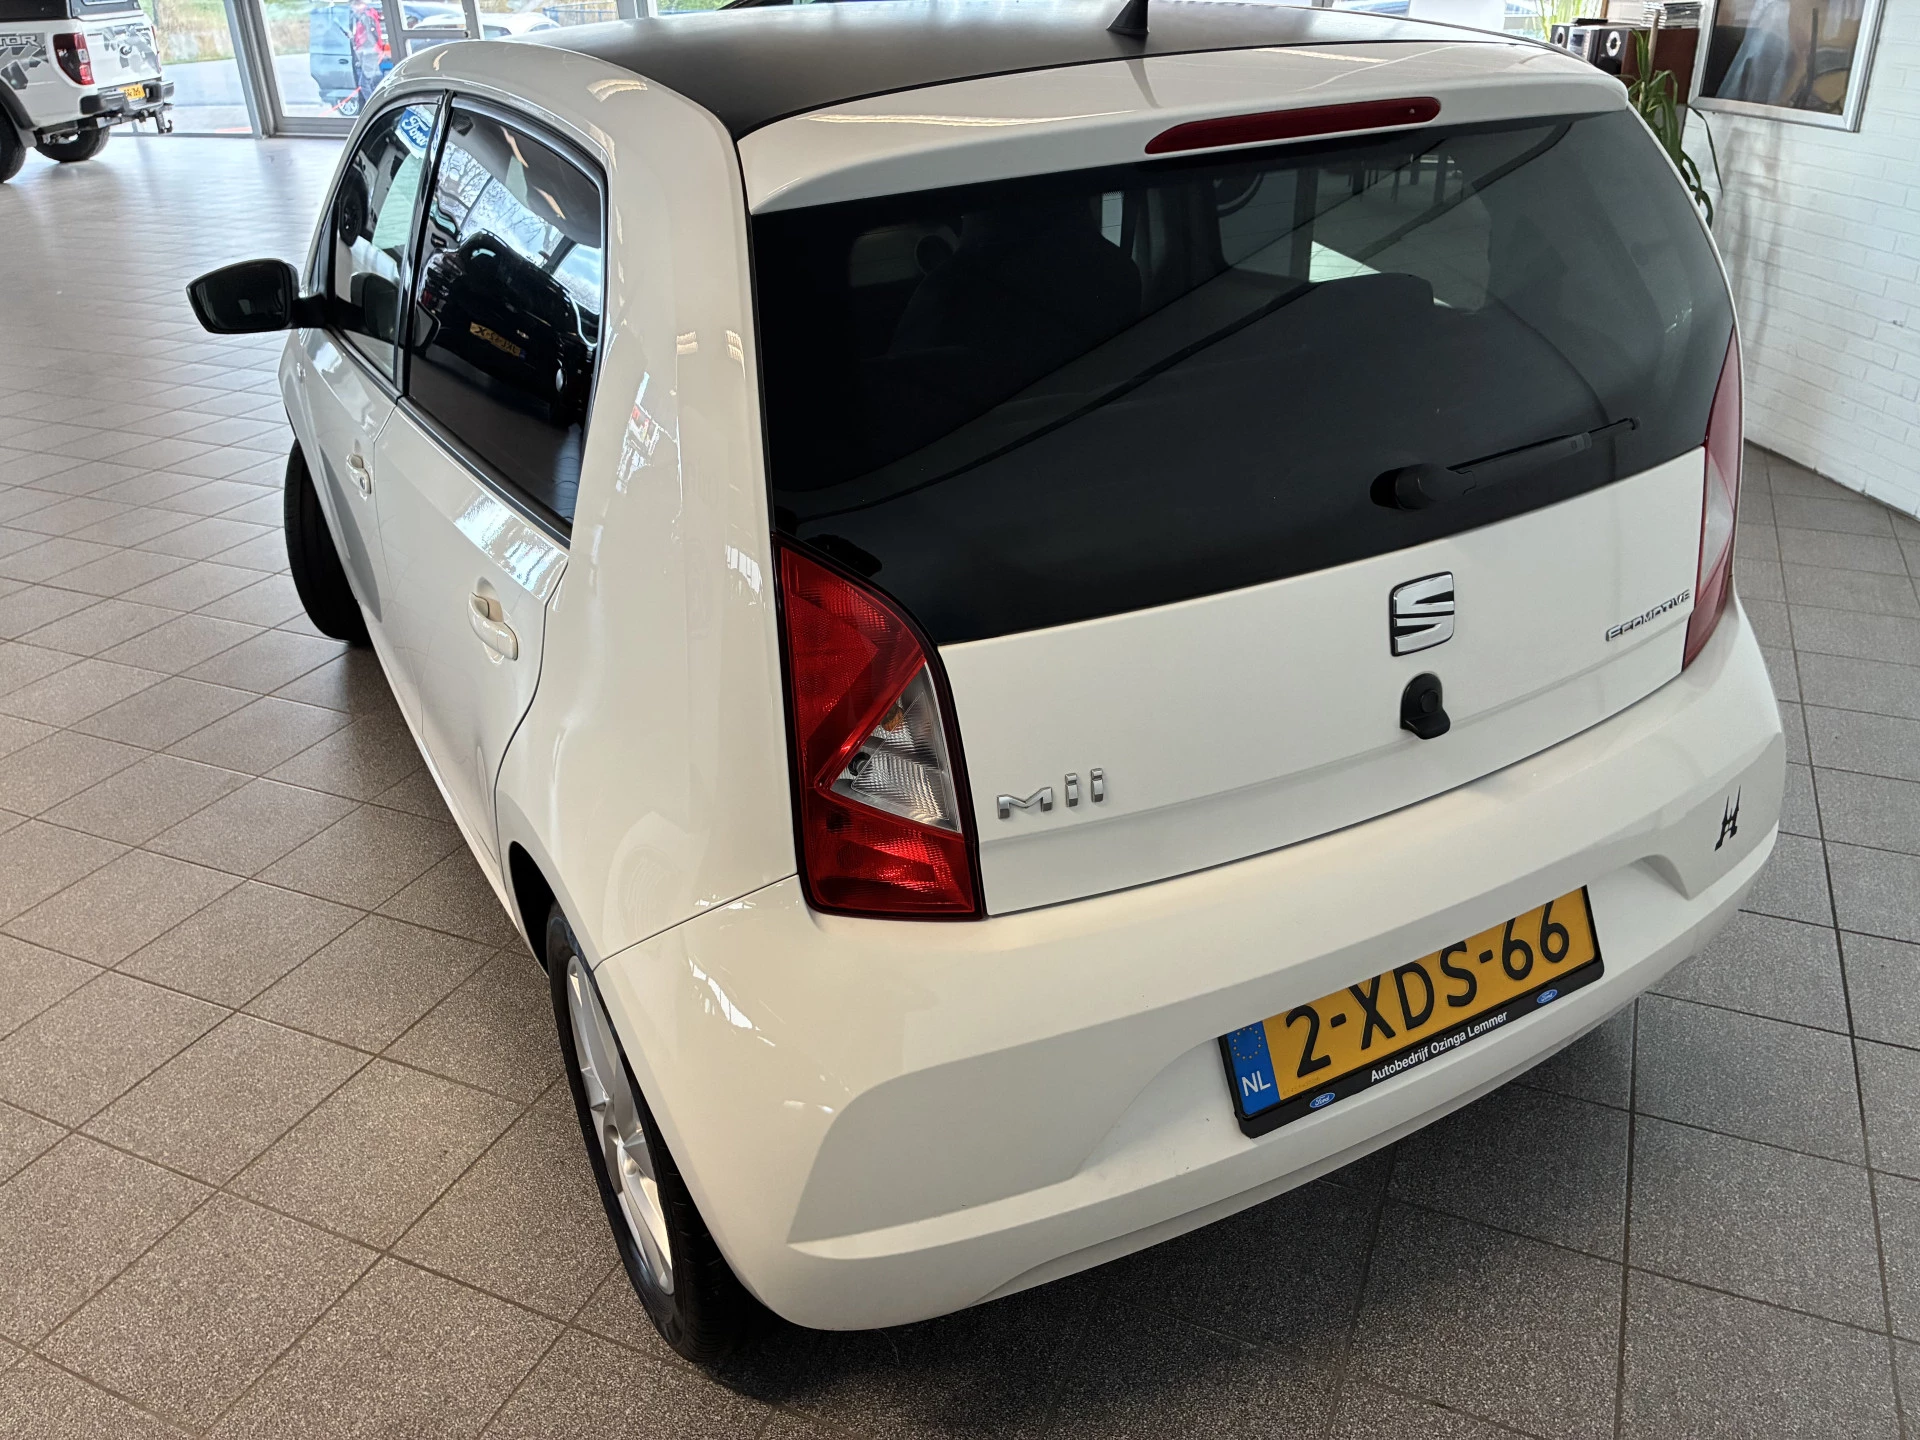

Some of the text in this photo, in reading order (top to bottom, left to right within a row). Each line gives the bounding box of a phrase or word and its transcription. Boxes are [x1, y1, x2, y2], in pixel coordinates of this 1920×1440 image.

[1286, 900, 1569, 1077] 2-XDS-66
[1371, 1047, 1429, 1082] Autobedrijf
[1430, 1031, 1466, 1054] Ozinga
[1467, 1011, 1508, 1037] Lemmer
[1242, 1071, 1271, 1096] NL
